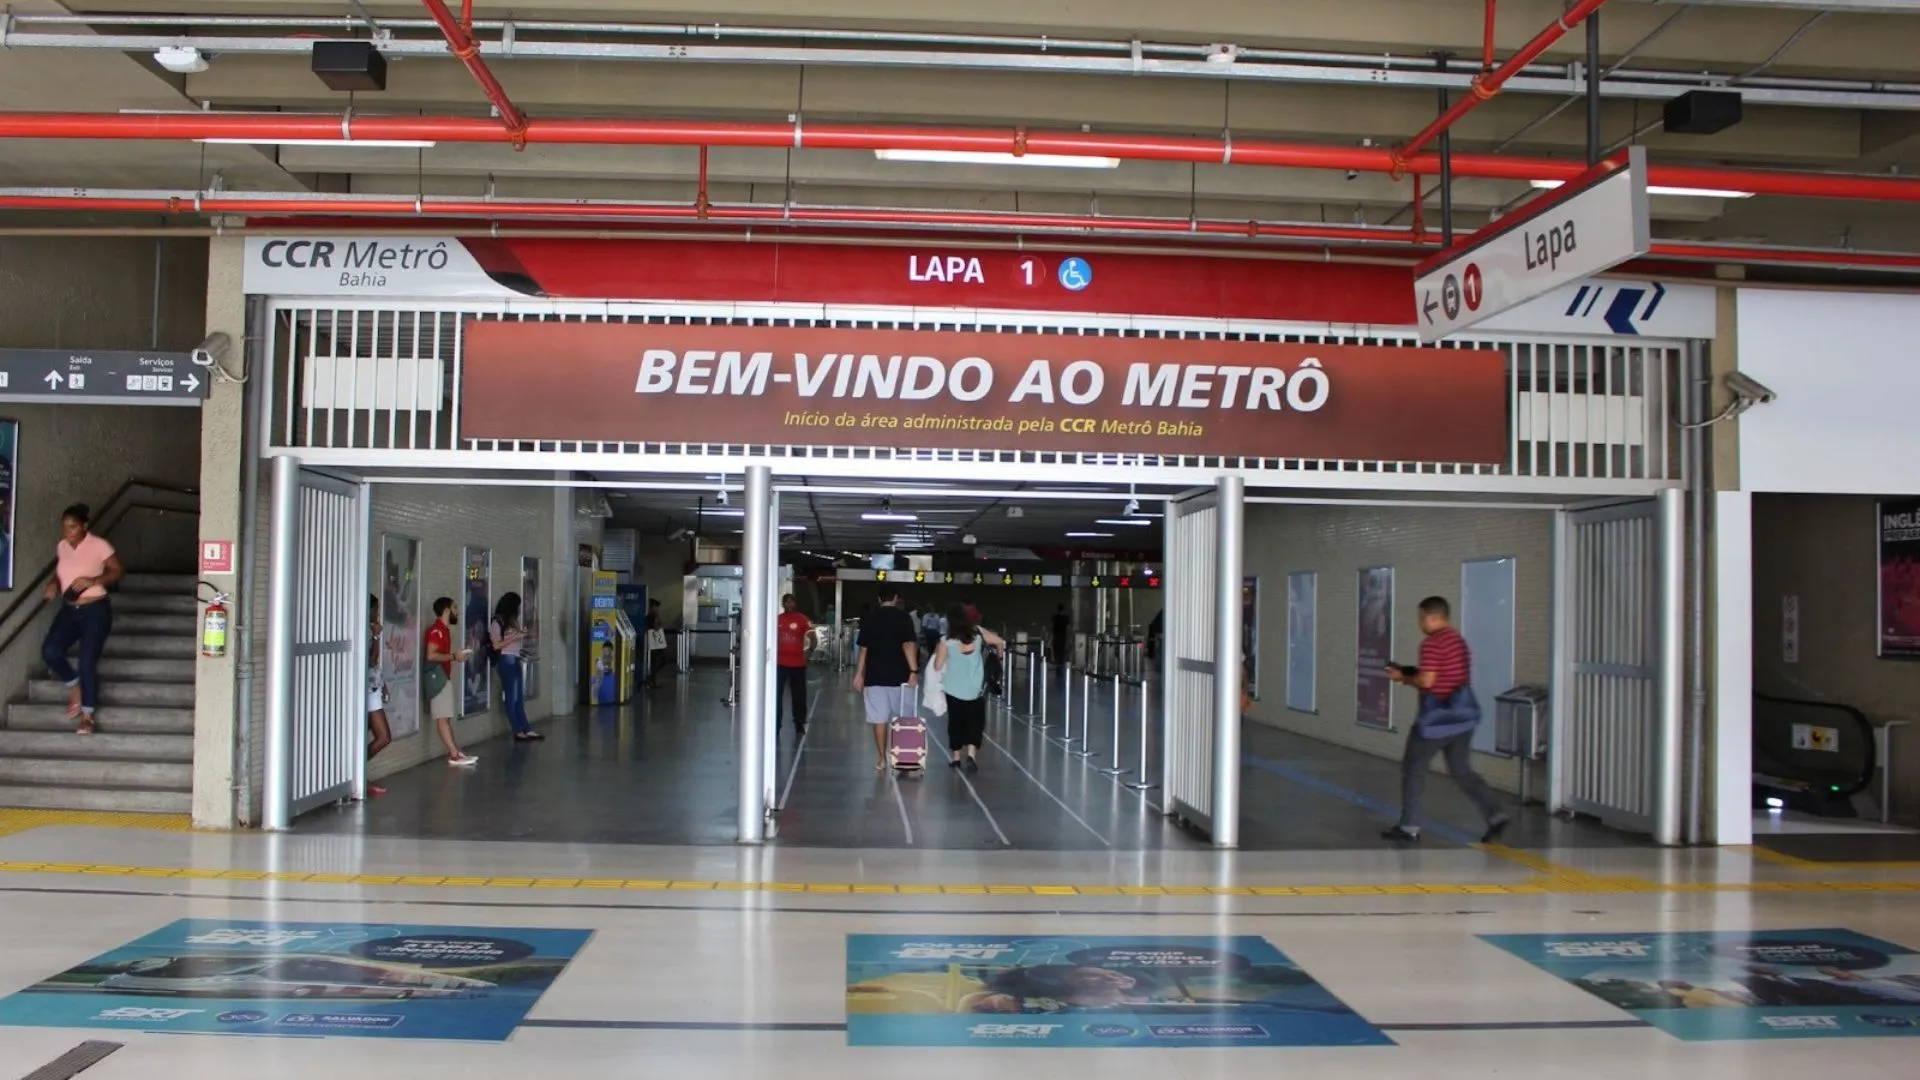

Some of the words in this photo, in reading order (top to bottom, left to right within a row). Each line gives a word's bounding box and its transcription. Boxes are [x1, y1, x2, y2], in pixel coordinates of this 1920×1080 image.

[261, 240, 335, 268] CCR
[343, 241, 449, 270] Metrô
[1524, 219, 1577, 271] Lapa
[339, 271, 387, 287] Bahia
[908, 255, 985, 284] LAPA
[1020, 260, 1033, 285] 1
[634, 349, 994, 402] BEM-VINDO
[1008, 359, 1105, 405] AO
[1121, 357, 1330, 413] METRÔ
[784, 411, 830, 427] Início
[835, 412, 856, 427] da
[860, 412, 899, 429] área
[903, 415, 1013, 431] administrada
[1017, 417, 1055, 435] pela
[1060, 418, 1096, 433] CCR
[1101, 418, 1152, 435] Metrô
[1157, 420, 1204, 437] Bahia
[892, 948, 1014, 960] BRT
[966, 1023, 1063, 1034] BRT
